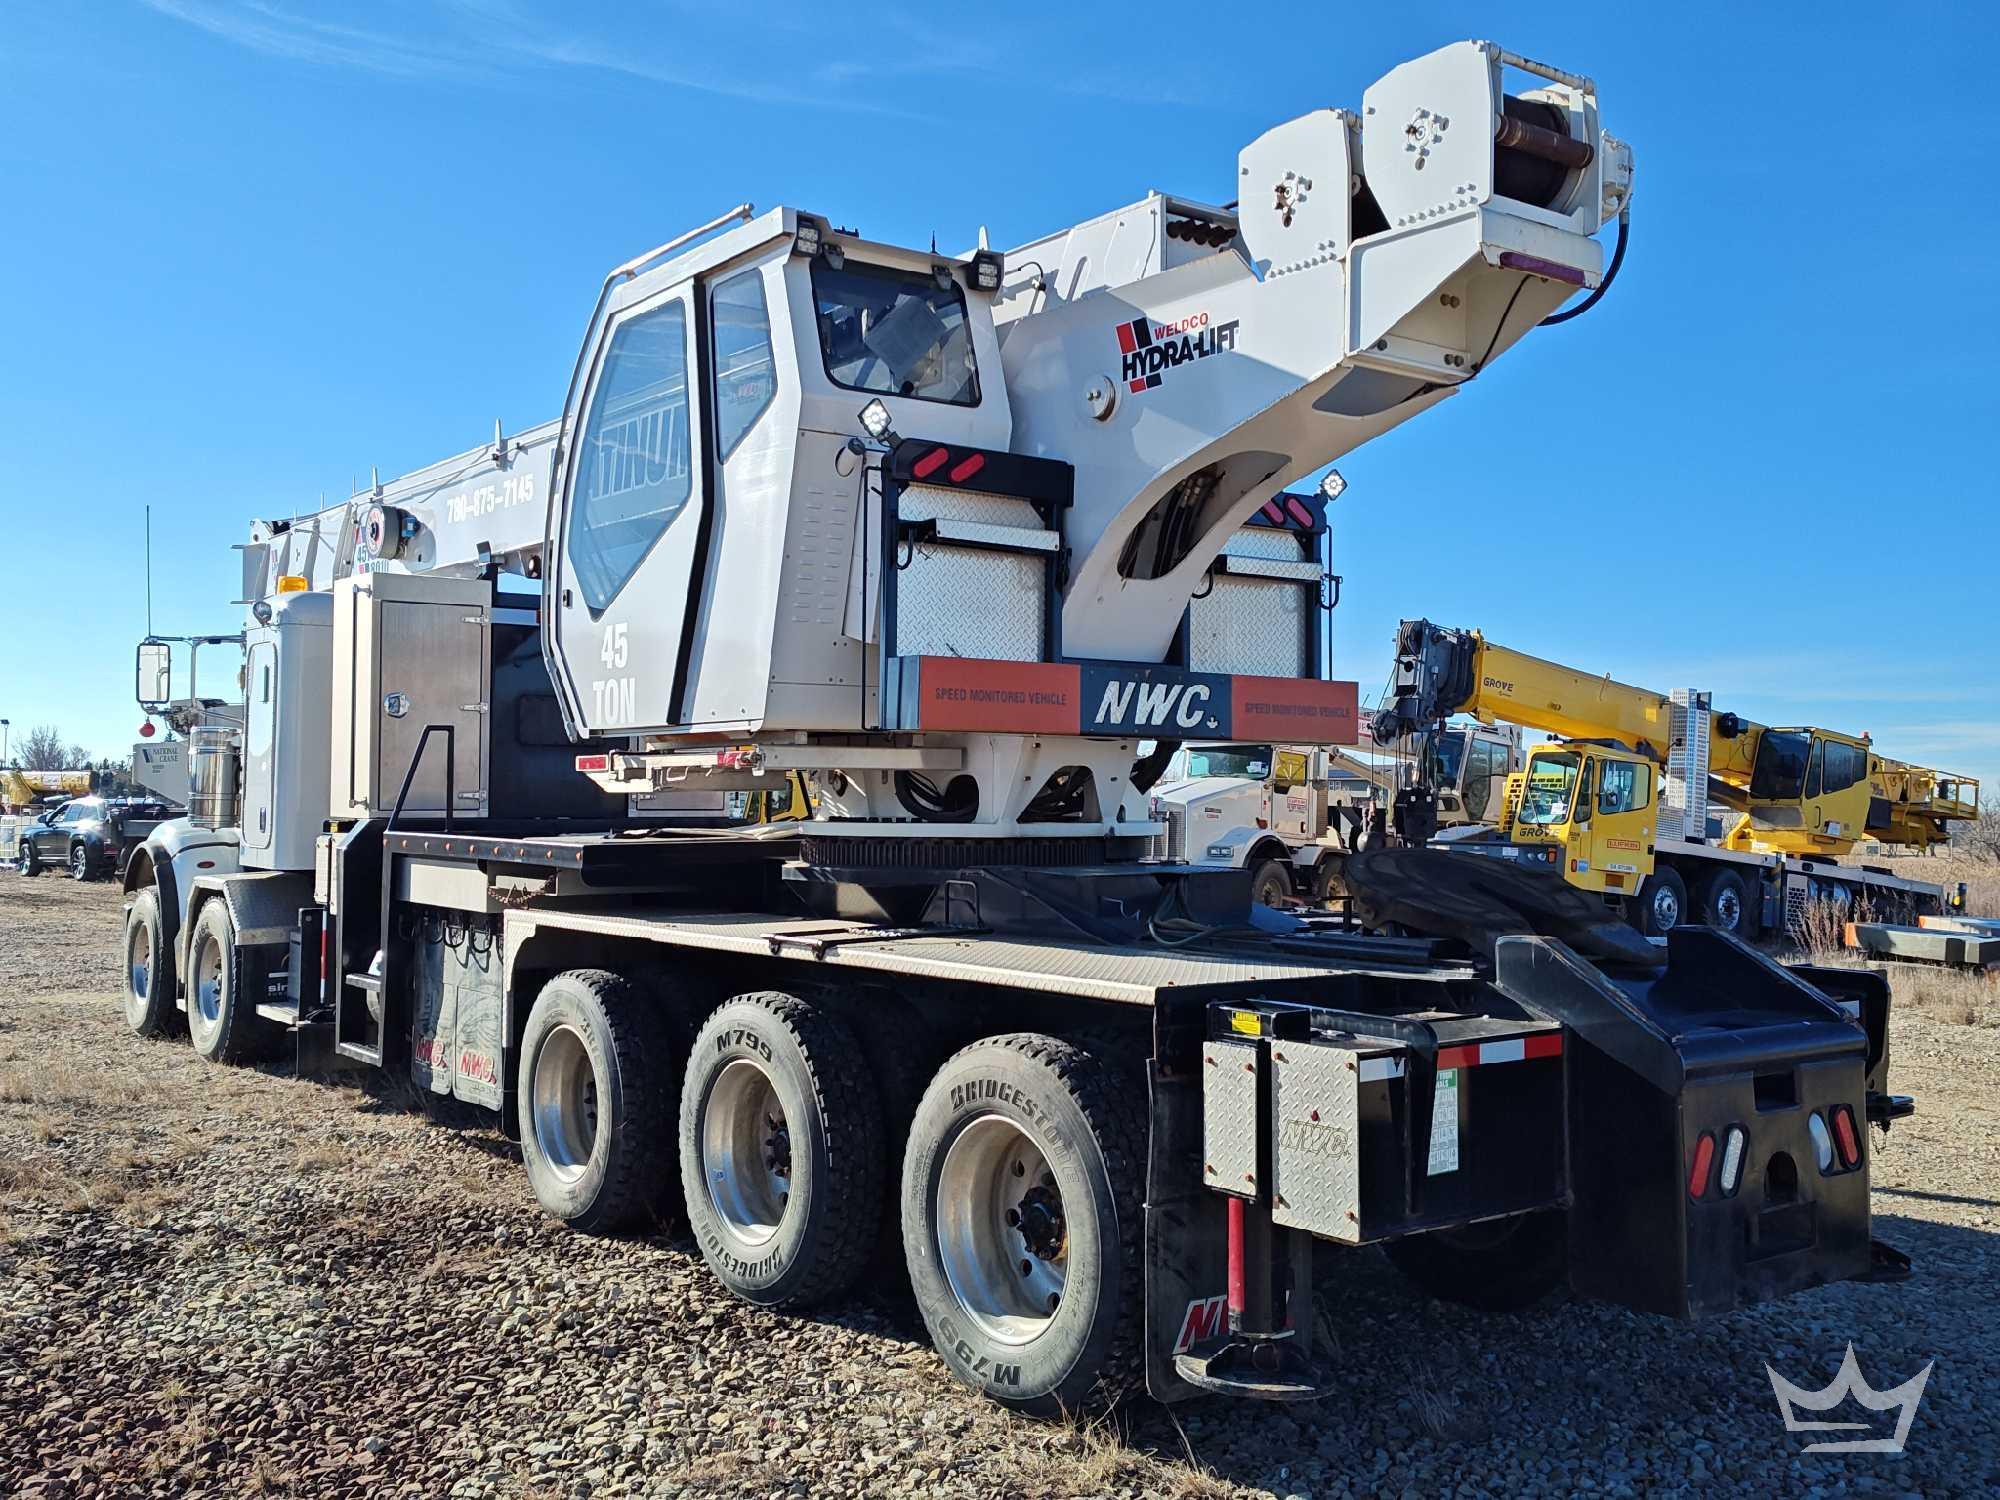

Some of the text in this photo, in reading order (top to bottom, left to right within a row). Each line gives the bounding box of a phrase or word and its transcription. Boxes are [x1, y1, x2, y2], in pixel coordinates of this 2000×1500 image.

[1154, 312, 1209, 340] WELDCO
[1122, 319, 1240, 381] HYDRA-LIFT
[447, 473, 534, 523] 780-875-7145
[601, 622, 628, 669] 45
[592, 677, 636, 725] TON
[935, 687, 1067, 706] SPEED MONITORED VEHICLE
[1483, 676, 1514, 692] GROVE
[1519, 827, 1561, 838] GROVE
[716, 1029, 772, 1063] M799
[951, 1078, 1082, 1184] BRIDGESTONE
[693, 1208, 785, 1279] BRIDGESTONE
[938, 1316, 1021, 1388] M799
